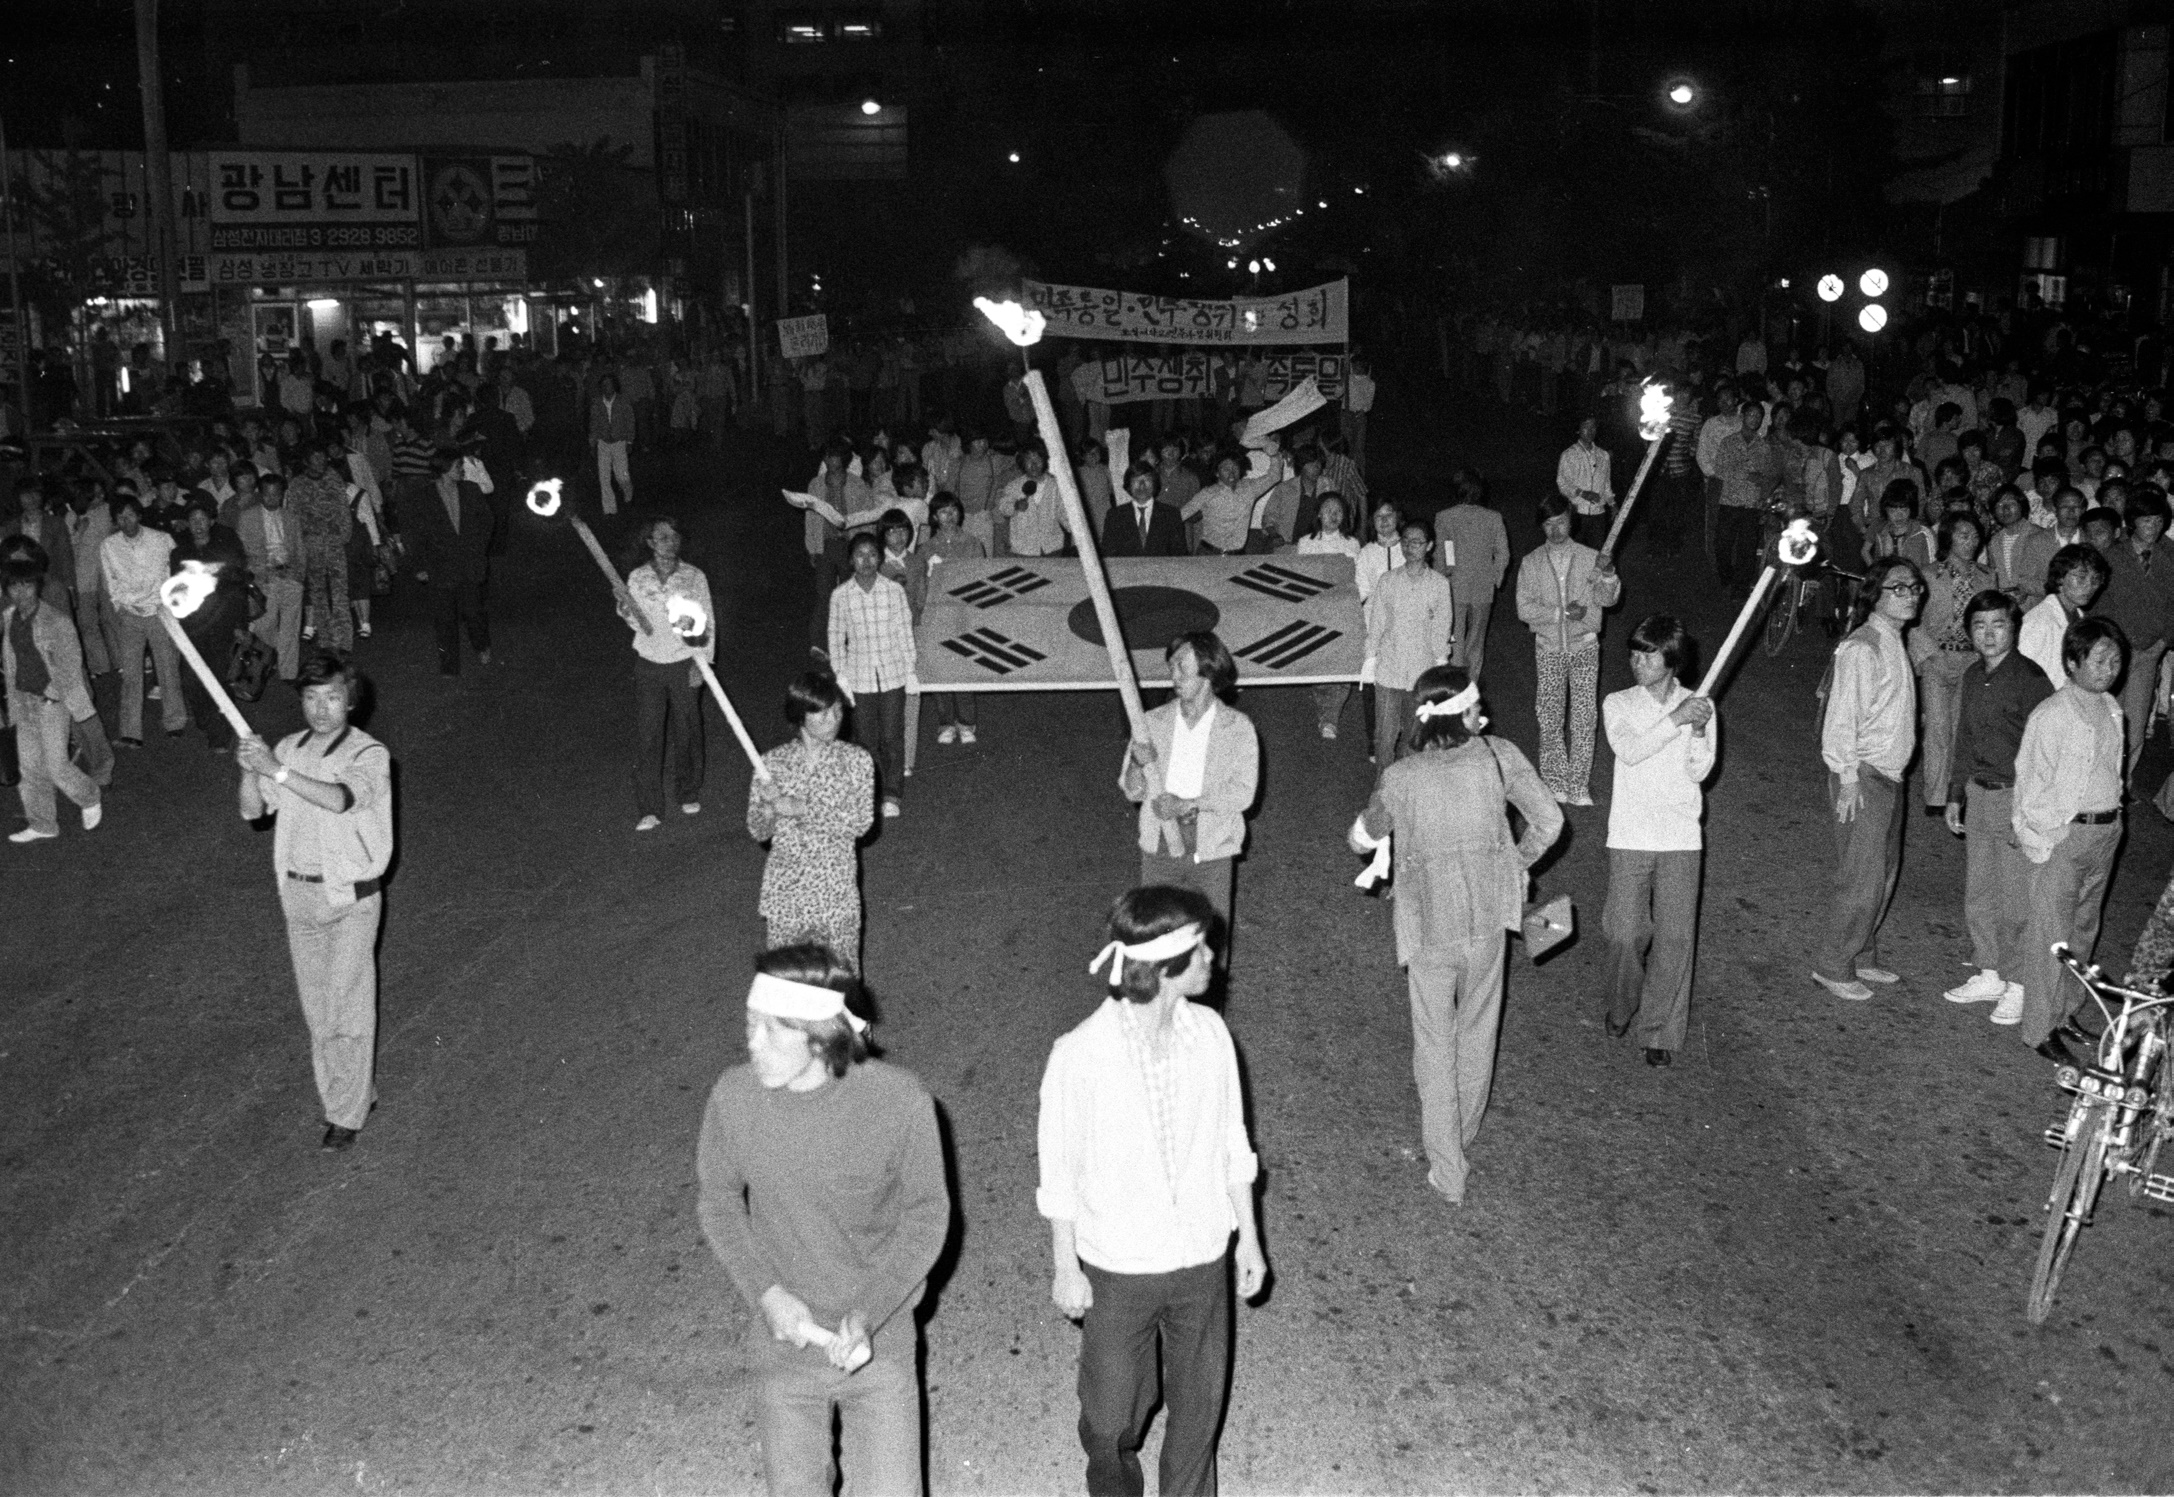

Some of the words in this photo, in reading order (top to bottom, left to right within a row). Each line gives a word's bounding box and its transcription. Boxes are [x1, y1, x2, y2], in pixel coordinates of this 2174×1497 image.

[220, 165, 409, 210] 광남센터
[213, 228, 308, 248] 삼성전자대리점
[219, 259, 253, 280] 삼성
[261, 262, 313, 278] 냉장고
[318, 260, 351, 276] TV
[359, 260, 410, 276] 세탁기
[1102, 355, 1211, 398] 민주쟁취
